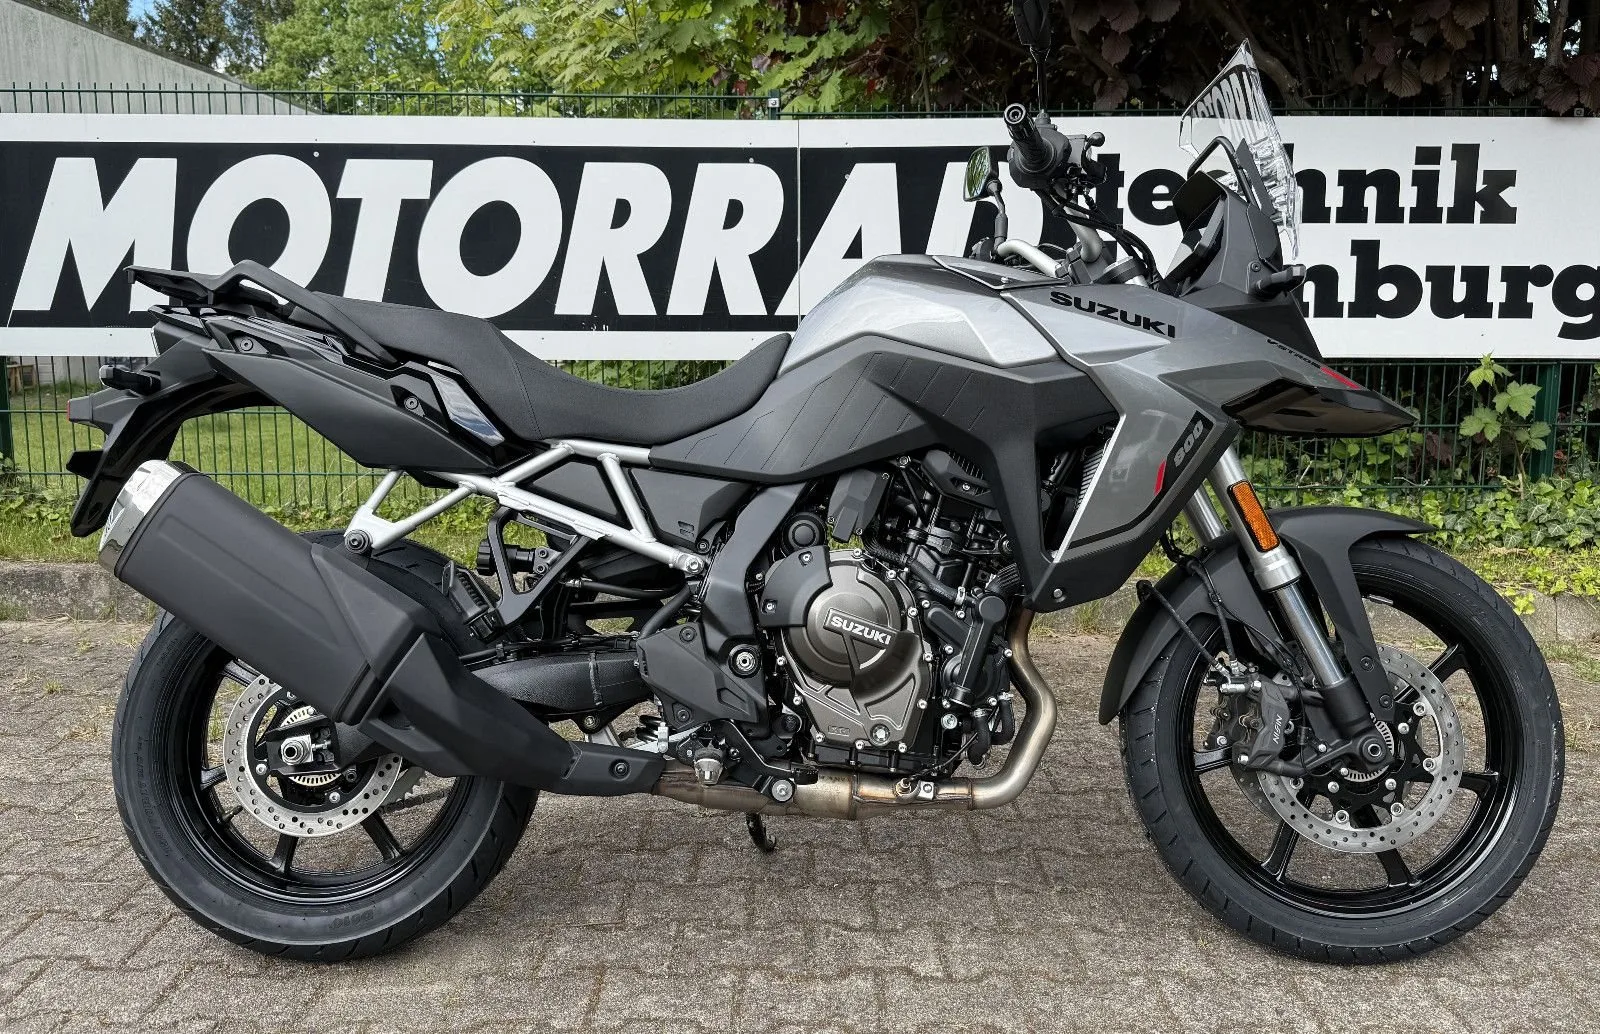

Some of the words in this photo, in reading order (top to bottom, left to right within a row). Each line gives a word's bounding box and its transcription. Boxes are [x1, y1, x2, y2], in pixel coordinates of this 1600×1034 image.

[11, 153, 1044, 319] MOTORRAD
[1096, 143, 1517, 225] tenik
[1050, 291, 1176, 338] SUZUKI
[1173, 419, 1204, 468] 800
[830, 615, 892, 646] SUZUKI
